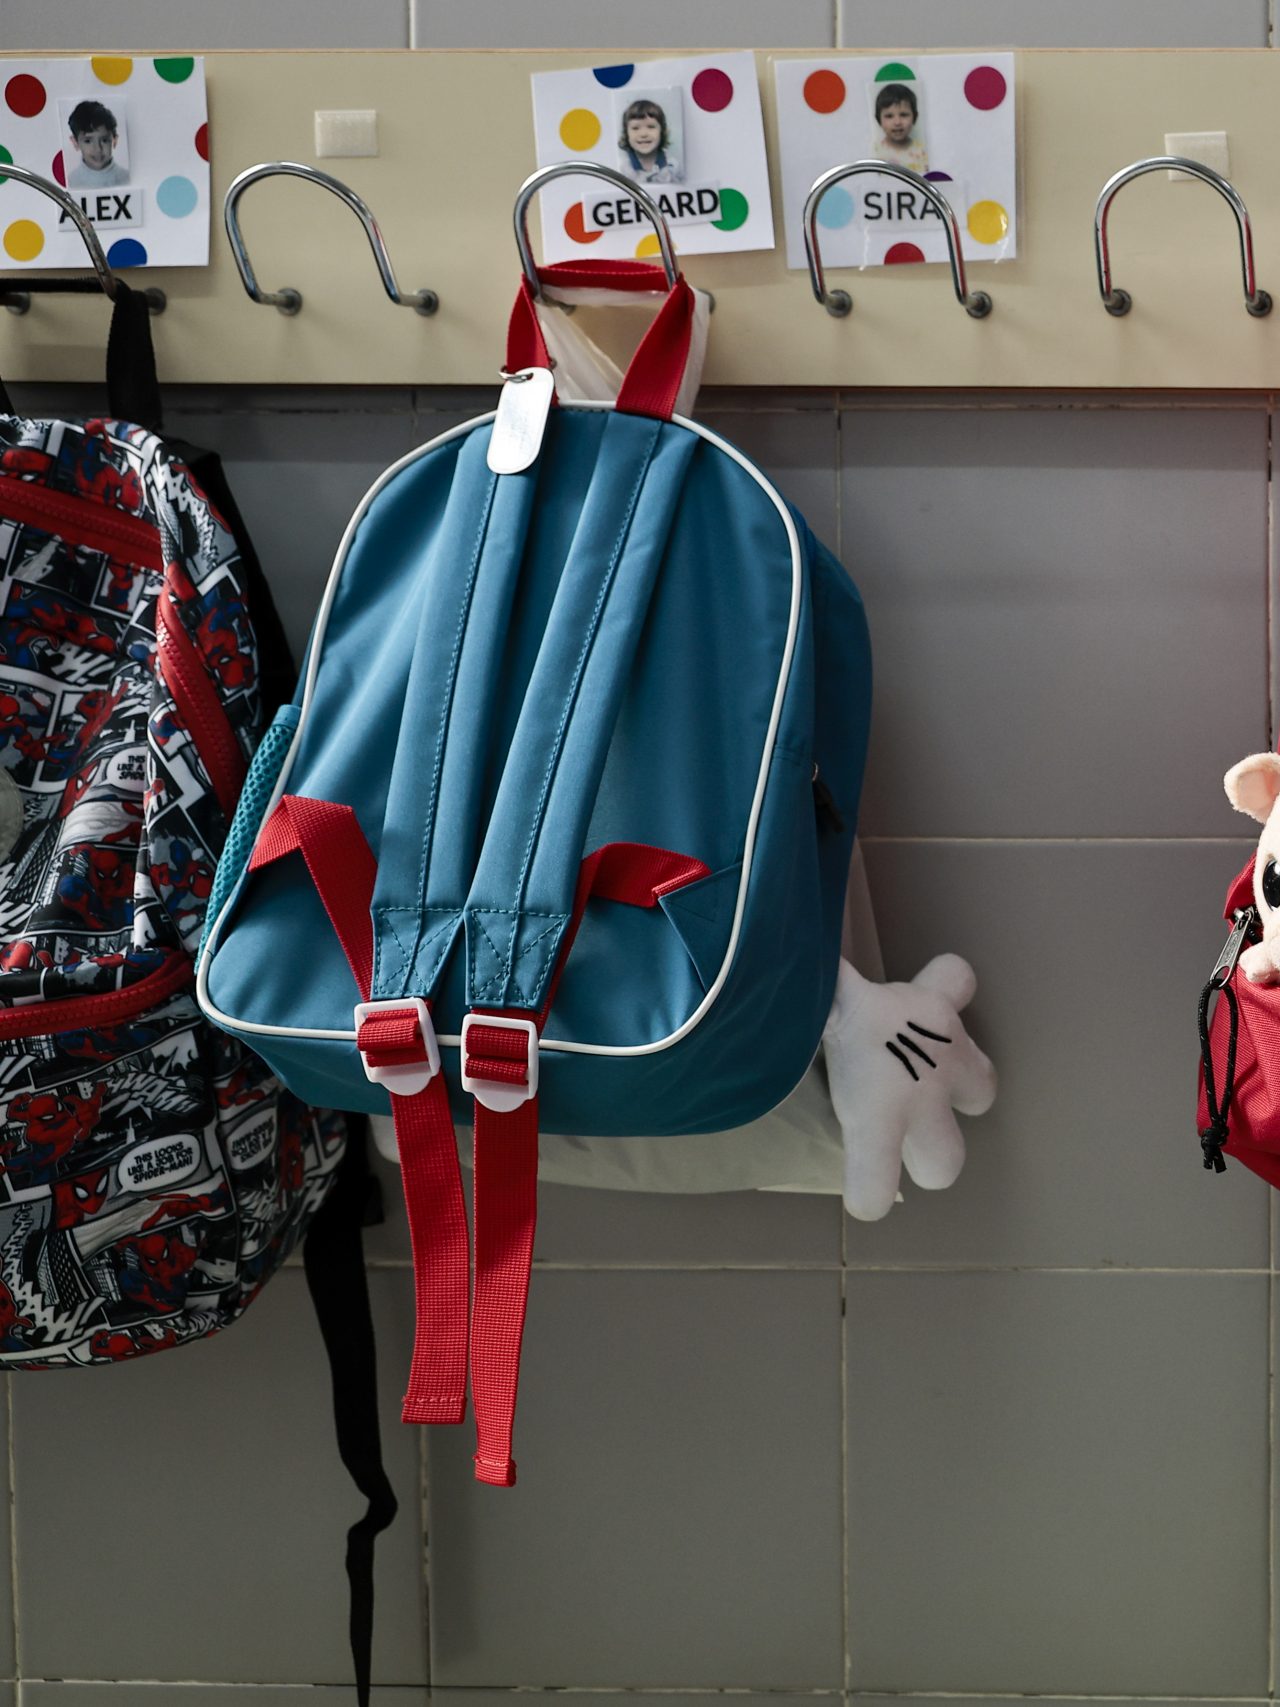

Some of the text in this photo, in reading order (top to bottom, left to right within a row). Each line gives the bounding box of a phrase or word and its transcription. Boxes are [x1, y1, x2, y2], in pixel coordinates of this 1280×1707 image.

[863, 191, 941, 220] SIRA
[127, 1163, 144, 1176] LIKE
[147, 1160, 154, 1171] A
[176, 1147, 193, 1160] FOR
[134, 1141, 184, 1165] THIS LOOKS
